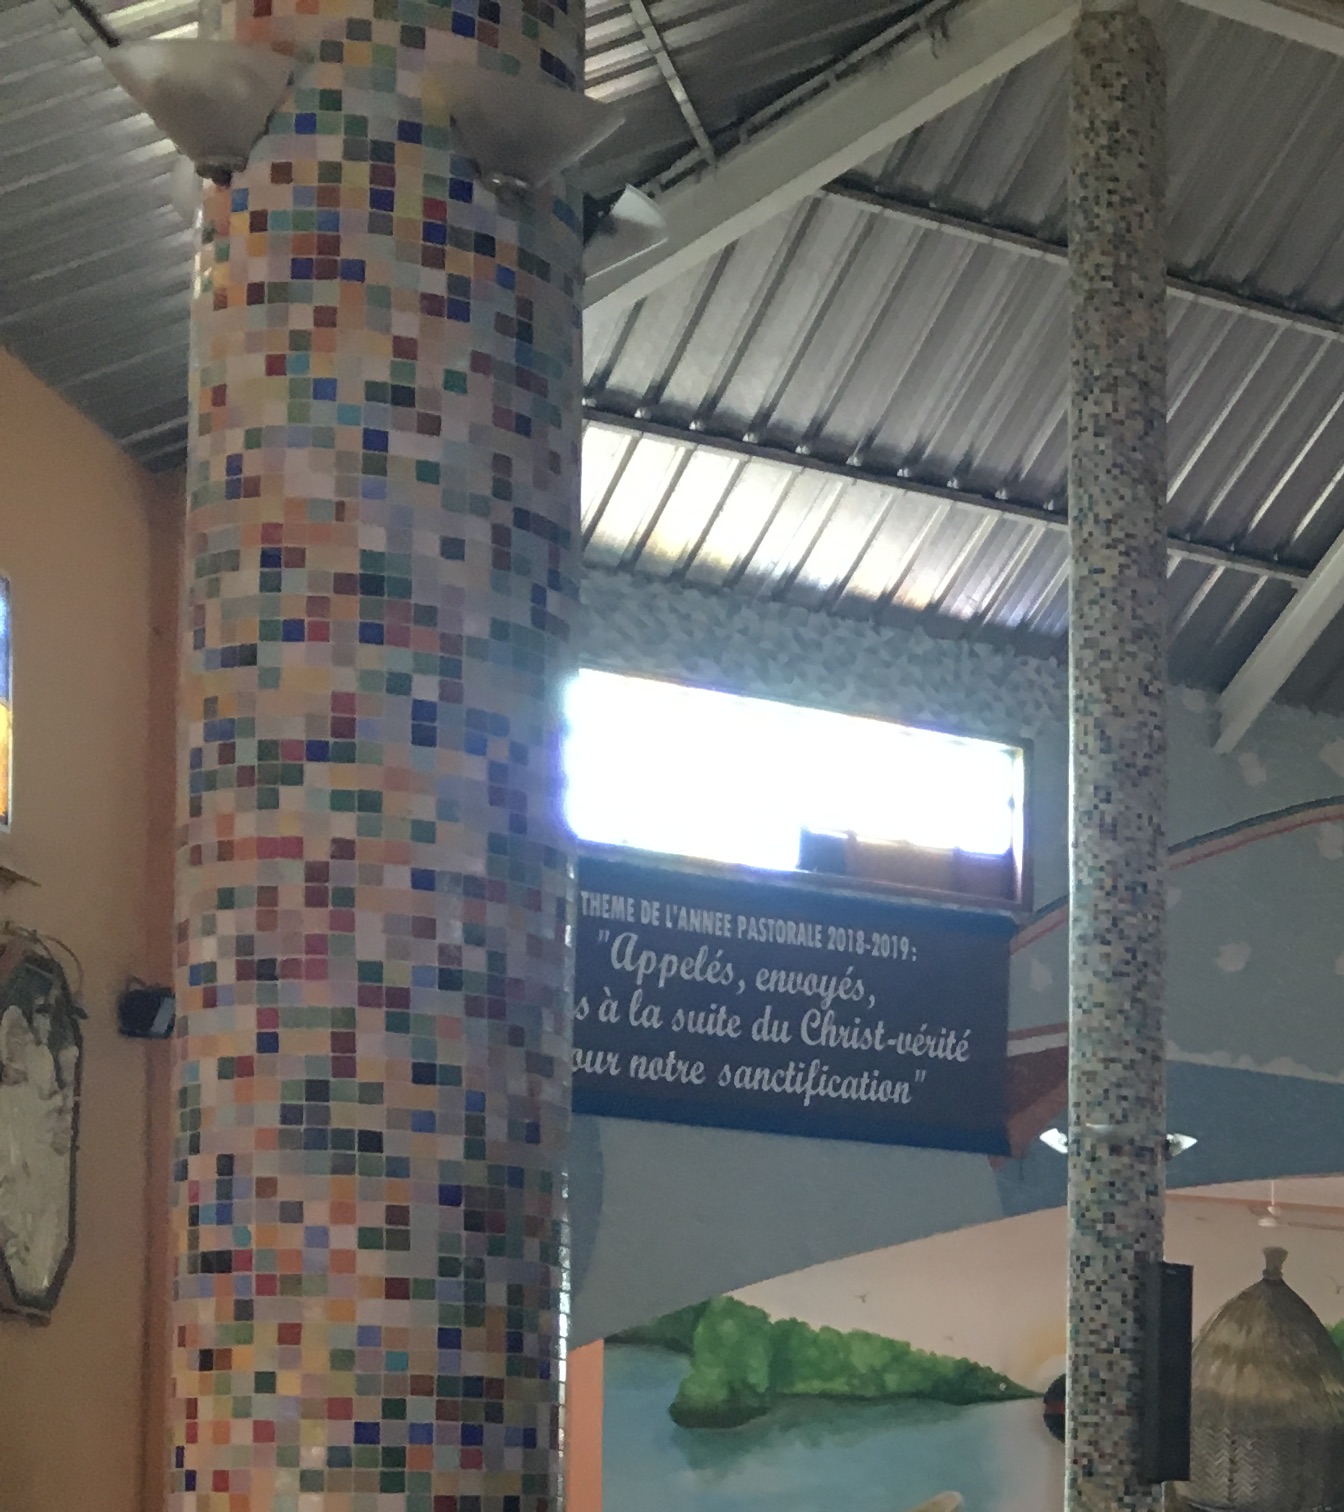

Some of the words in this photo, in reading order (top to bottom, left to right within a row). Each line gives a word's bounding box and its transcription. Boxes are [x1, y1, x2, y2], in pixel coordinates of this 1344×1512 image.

[580, 889, 636, 922] THEME
[641, 899, 660, 926] DE
[666, 904, 732, 938] L'ANNEE
[737, 914, 823, 948] PASTORALE
[828, 926, 918, 962] 2018-2019:
[755, 966, 876, 1011] envoyés,
[598, 986, 621, 1022] à
[629, 988, 664, 1029] la
[671, 1003, 743, 1038] suite
[751, 1004, 793, 1043] du
[800, 1008, 972, 1062] Christ-vérité
[571, 1047, 622, 1076] our
[629, 1051, 707, 1085] notre
